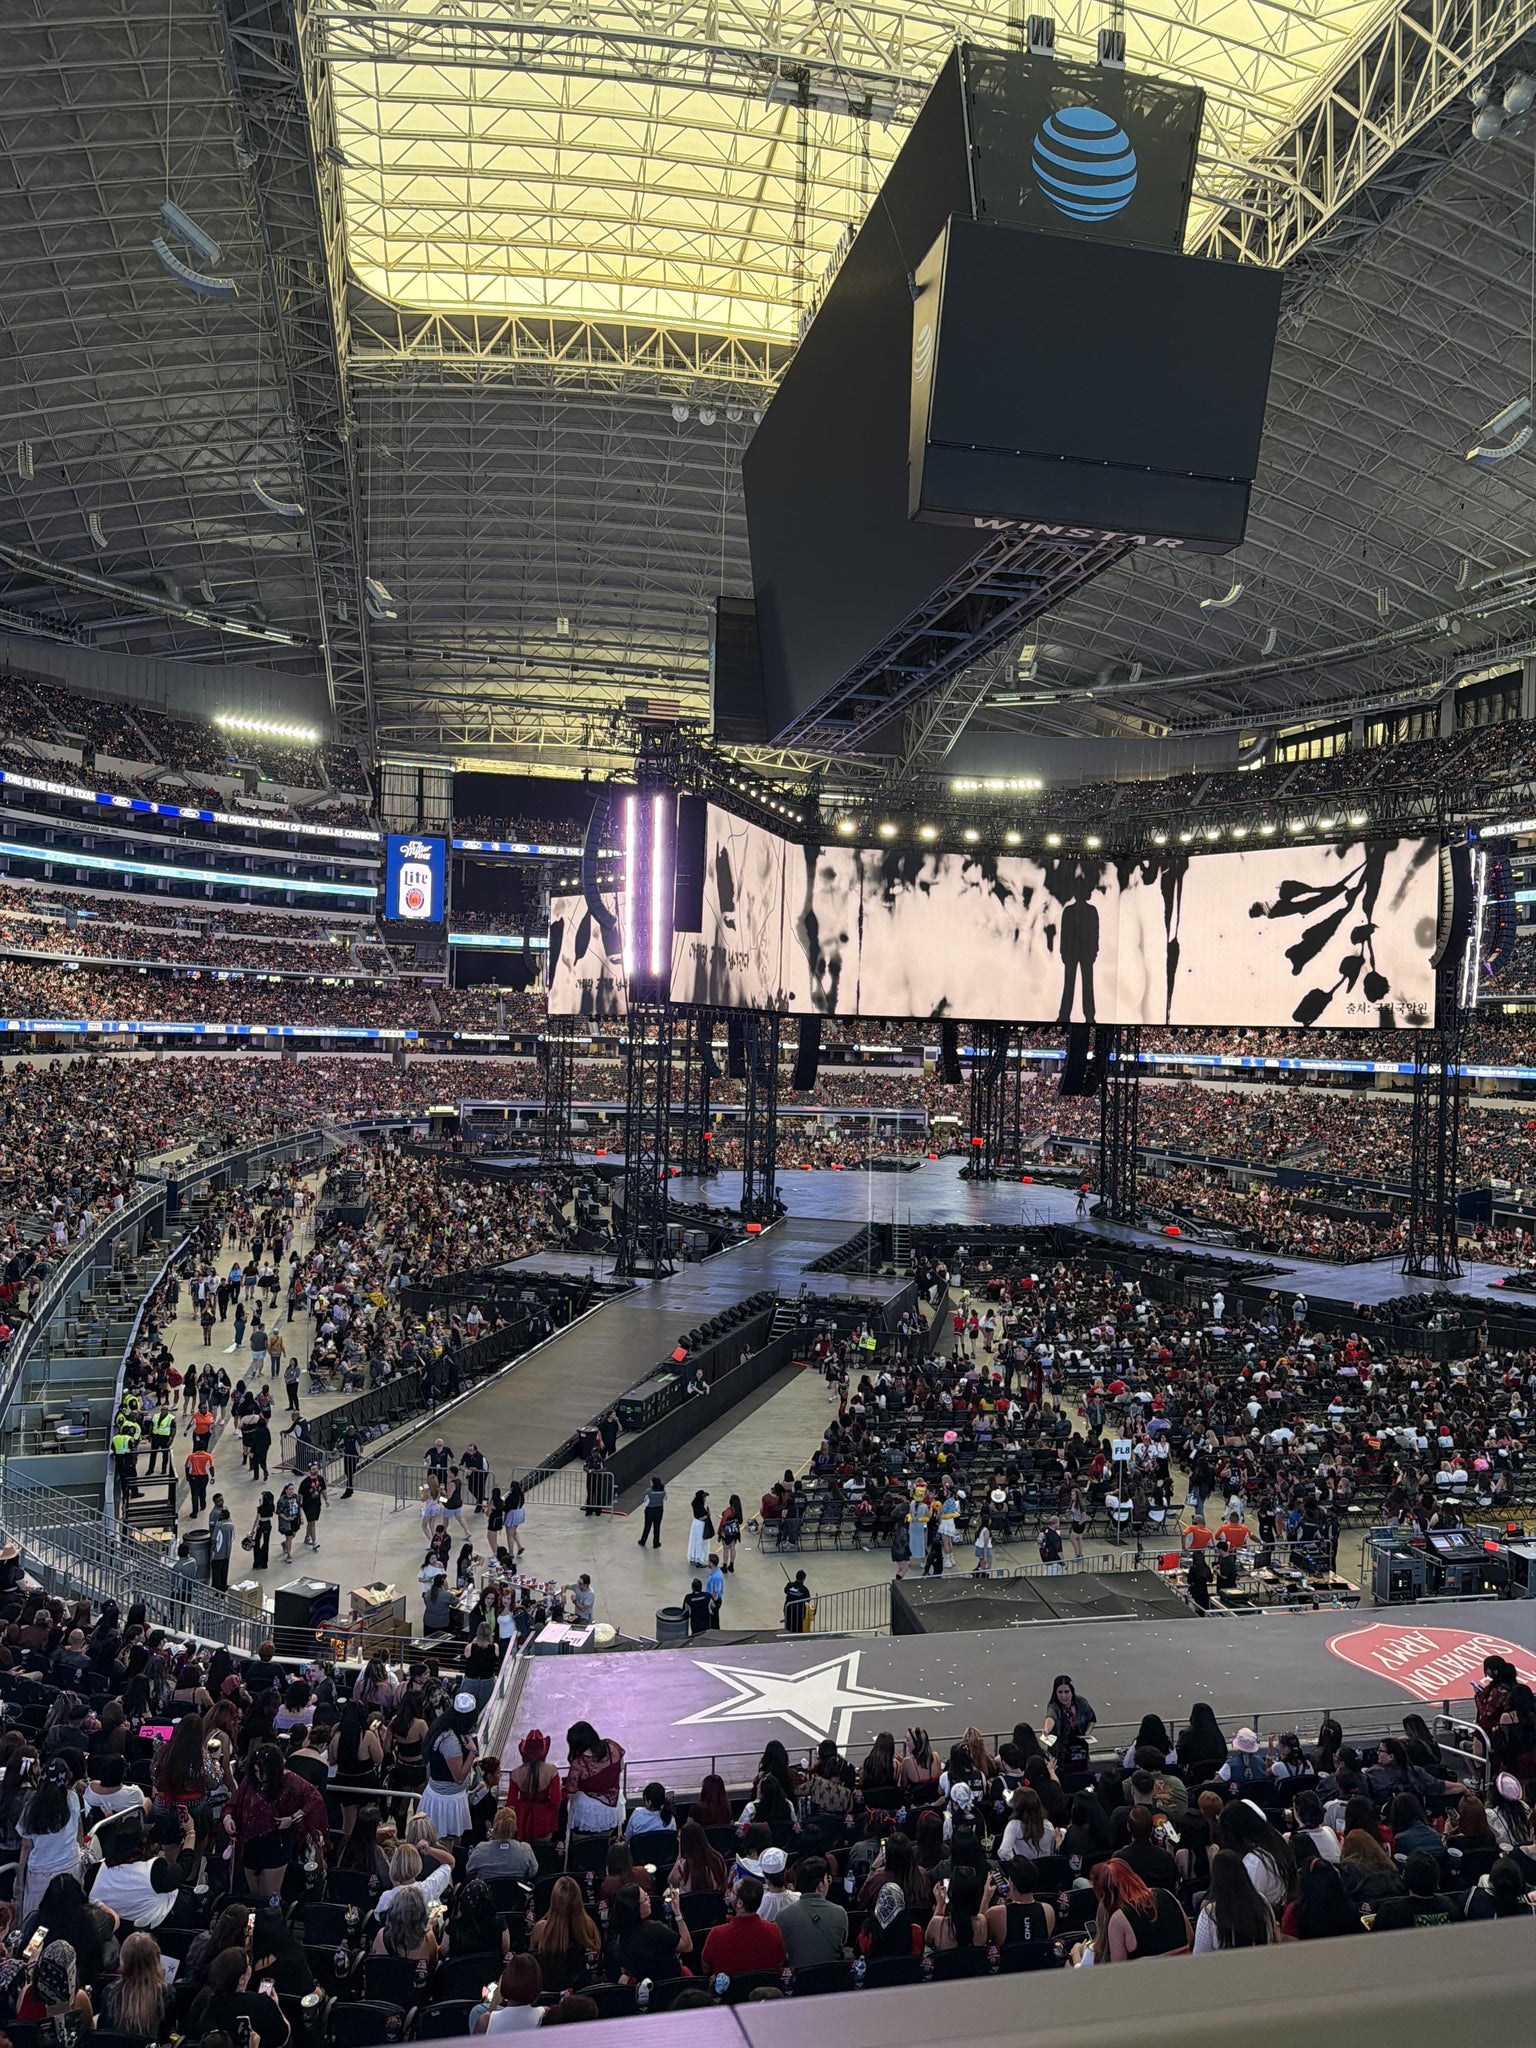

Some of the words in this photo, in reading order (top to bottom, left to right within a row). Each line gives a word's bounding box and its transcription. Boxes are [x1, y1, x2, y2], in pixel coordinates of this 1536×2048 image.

[973, 517, 1185, 549] WINSTAR
[404, 871, 428, 886] Lite
[1115, 1447, 1130, 1455] FL8
[1370, 1630, 1440, 1671] ARMY
[1400, 1636, 1515, 1696] SALVATION
